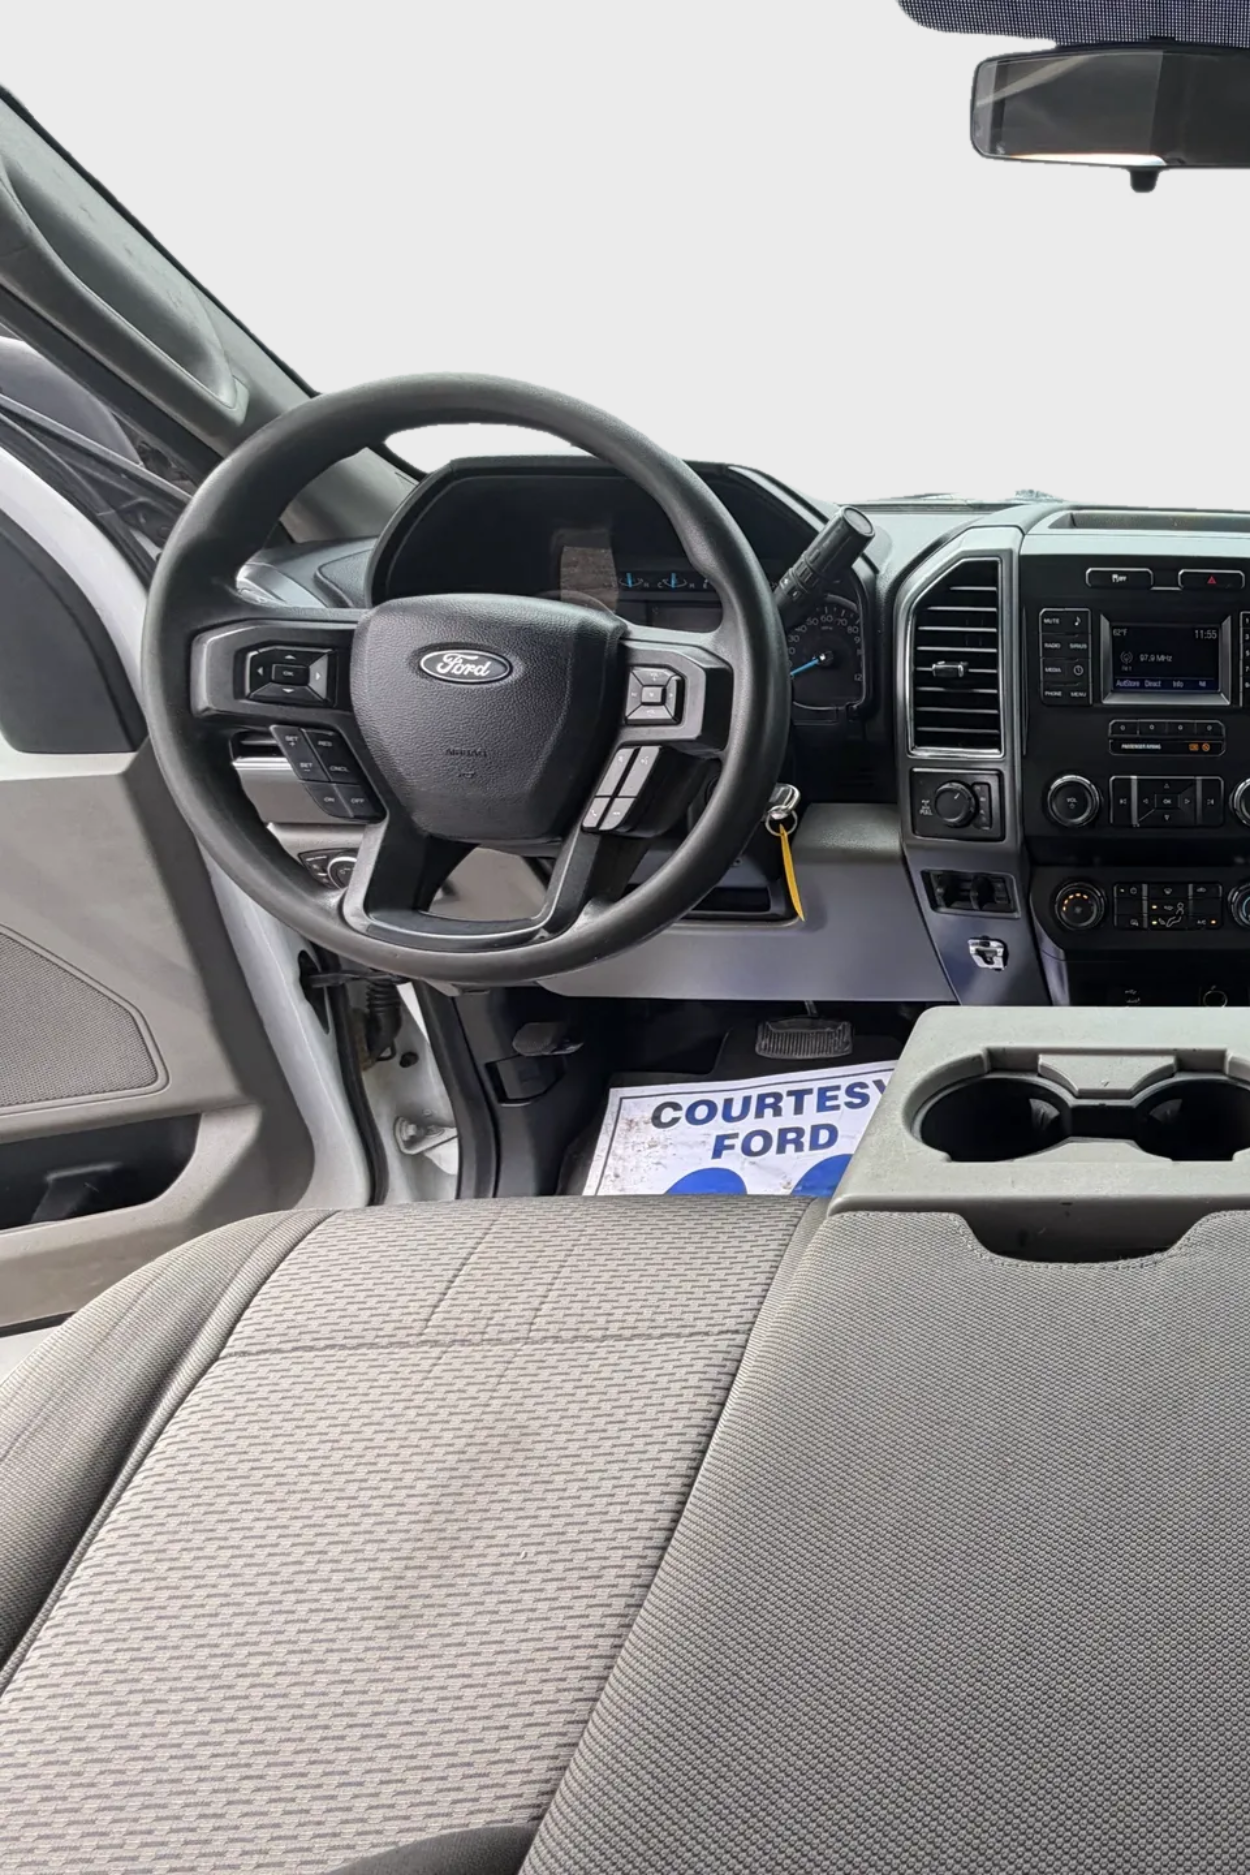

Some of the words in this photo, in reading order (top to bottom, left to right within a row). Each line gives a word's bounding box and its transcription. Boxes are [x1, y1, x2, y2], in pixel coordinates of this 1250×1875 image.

[820, 614, 833, 622] 60
[1194, 629, 1217, 639] 11:55
[436, 652, 492, 677] Ford
[1172, 680, 1185, 689] Info
[711, 1123, 839, 1160] FORD
